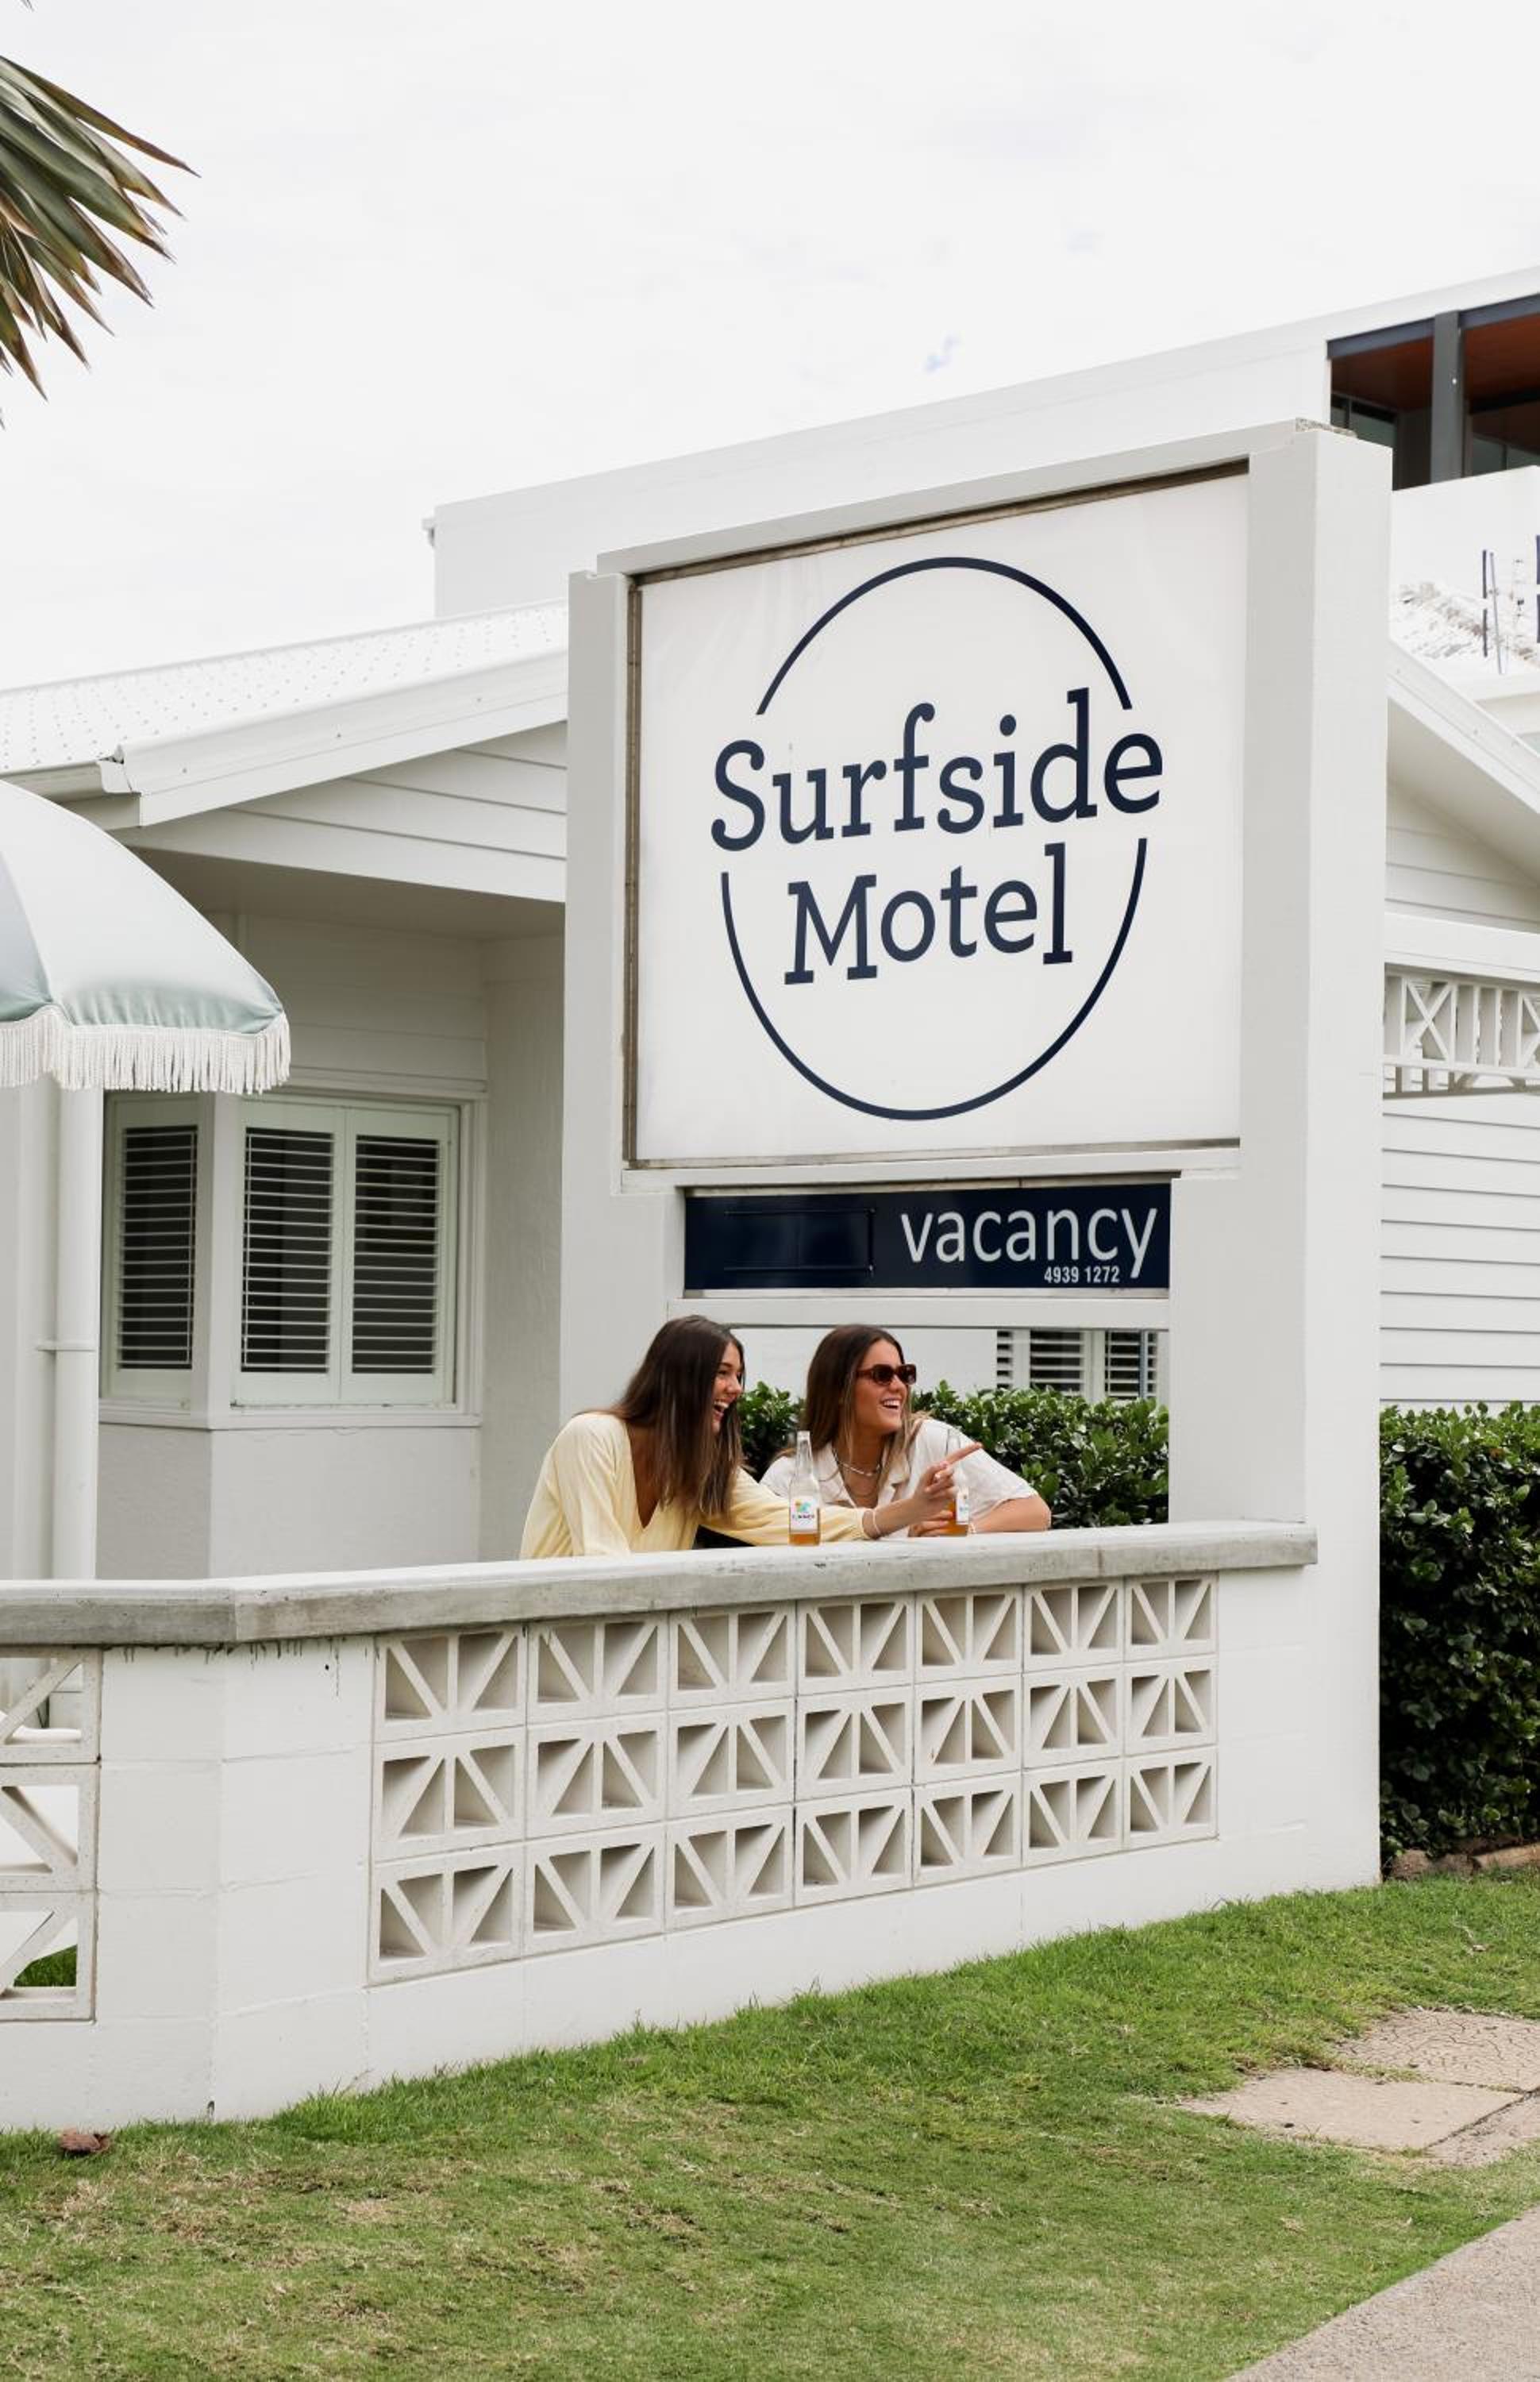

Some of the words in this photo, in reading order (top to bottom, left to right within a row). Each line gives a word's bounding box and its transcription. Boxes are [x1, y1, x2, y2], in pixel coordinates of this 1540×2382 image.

[710, 687, 1163, 852] Surfside
[784, 842, 1073, 985] Motel
[900, 1207, 1158, 1279] vacancy
[1044, 1266, 1080, 1284] 4939
[1084, 1265, 1120, 1283] 1272
